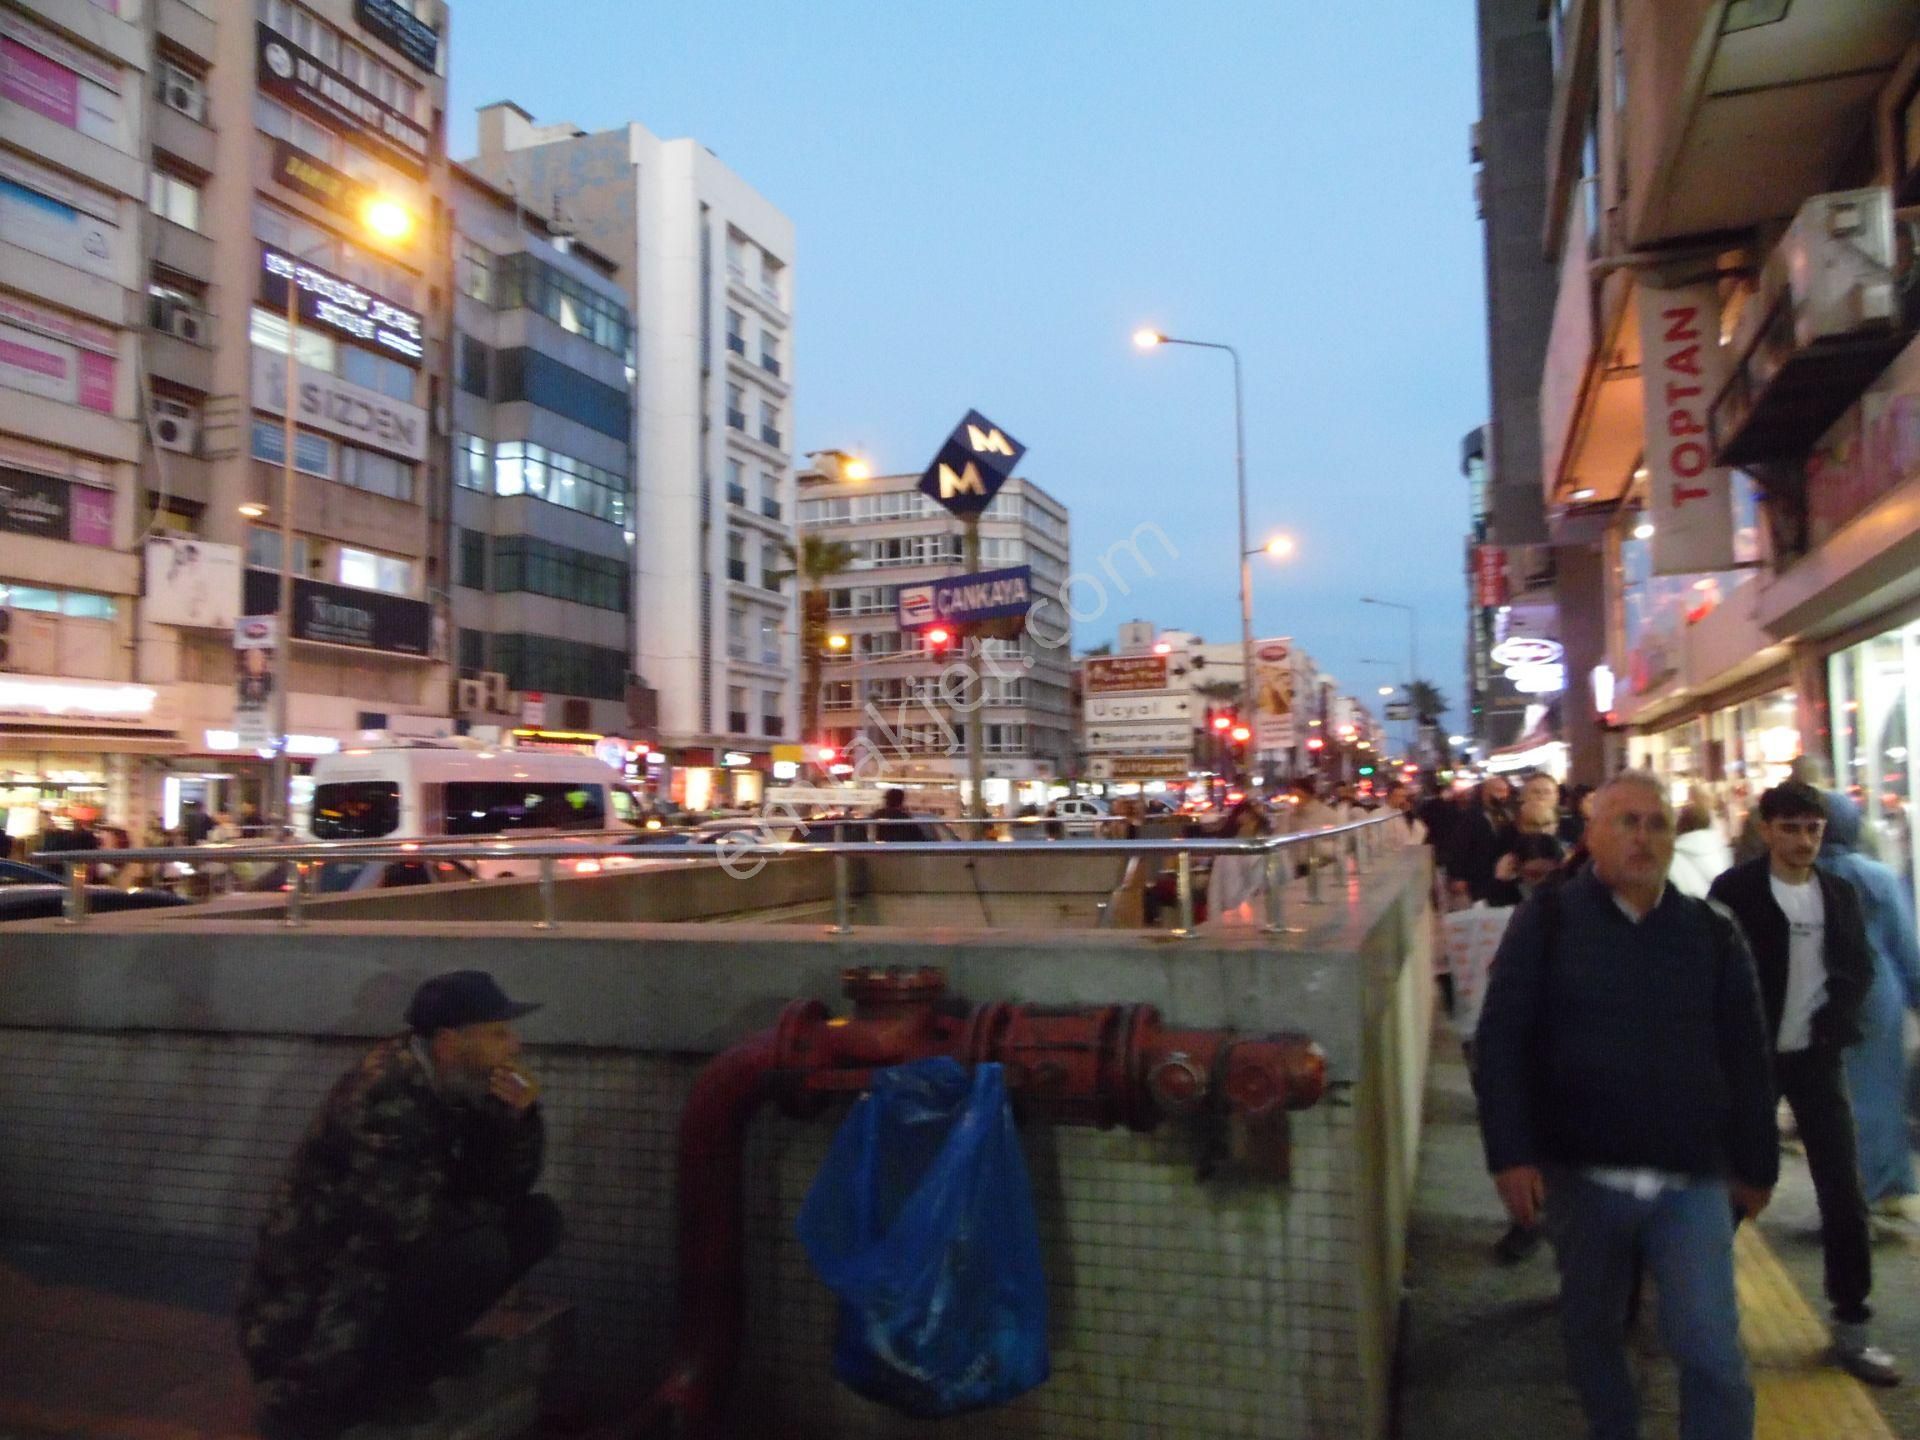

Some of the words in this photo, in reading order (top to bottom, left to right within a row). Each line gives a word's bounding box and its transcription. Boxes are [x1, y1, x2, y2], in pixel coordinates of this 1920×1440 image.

[1662, 306, 1711, 509] TOPTAN
[967, 424, 1015, 456] M
[938, 460, 986, 499] M
